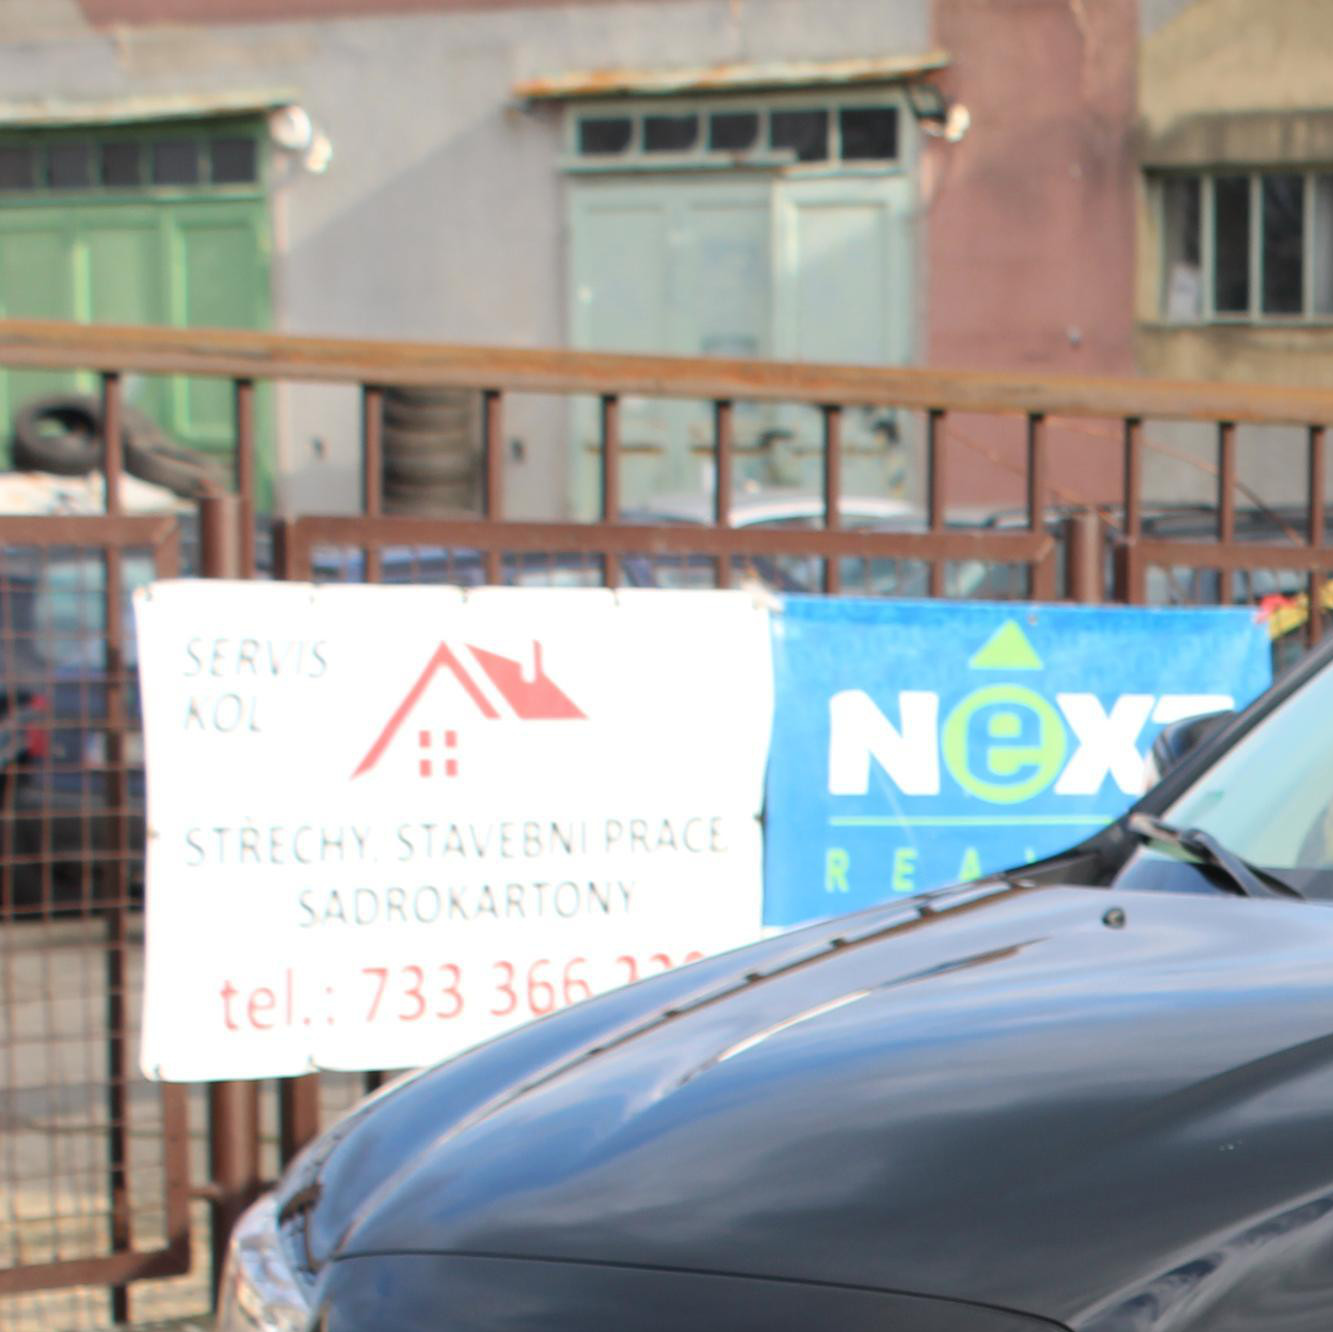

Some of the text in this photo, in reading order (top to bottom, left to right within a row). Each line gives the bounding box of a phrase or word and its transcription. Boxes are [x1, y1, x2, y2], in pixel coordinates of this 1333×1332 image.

[182, 637, 328, 678] SERVIS
[219, 967, 335, 1031] tel.:
[361, 964, 464, 1024] 733
[489, 956, 595, 1018] 366
